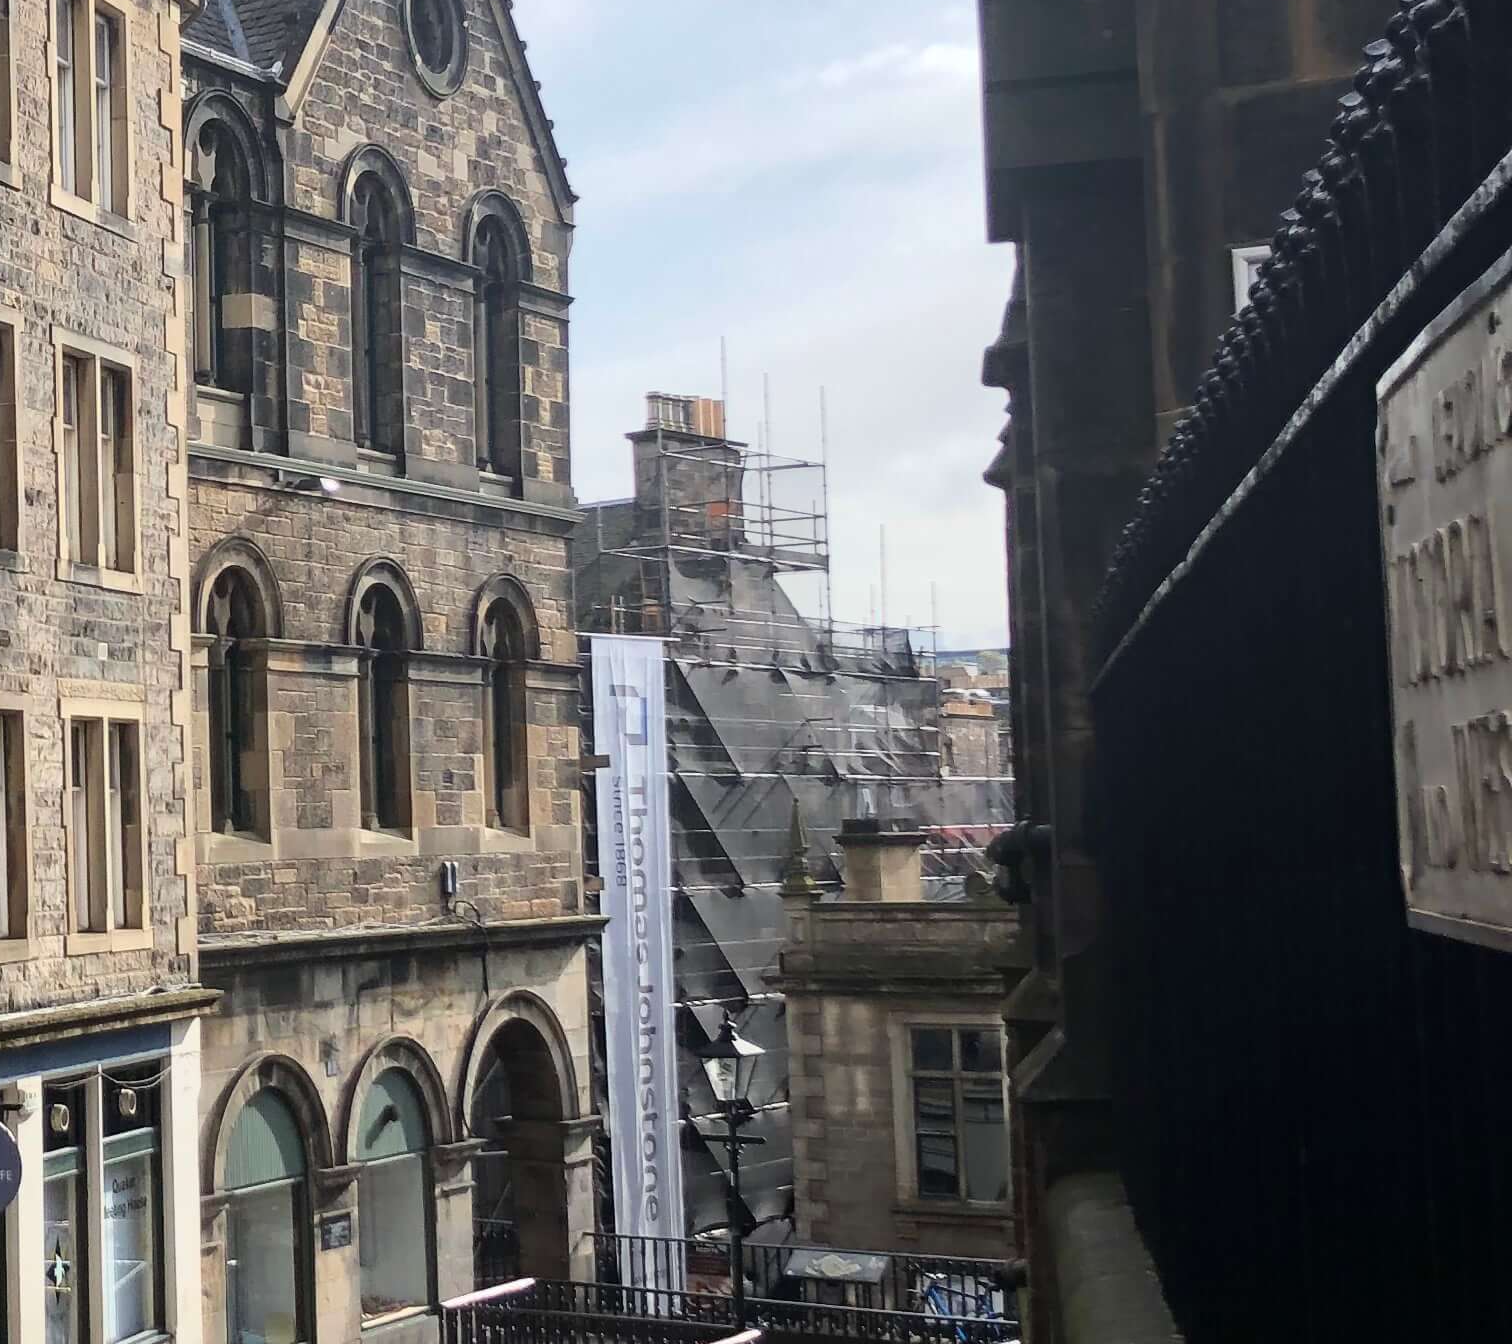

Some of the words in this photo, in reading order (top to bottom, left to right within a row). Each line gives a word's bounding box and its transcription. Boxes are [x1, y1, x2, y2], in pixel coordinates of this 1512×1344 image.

[615, 842, 628, 887] 1868
[630, 775, 648, 965] Thomas
[638, 975, 659, 1222] Johnstone
